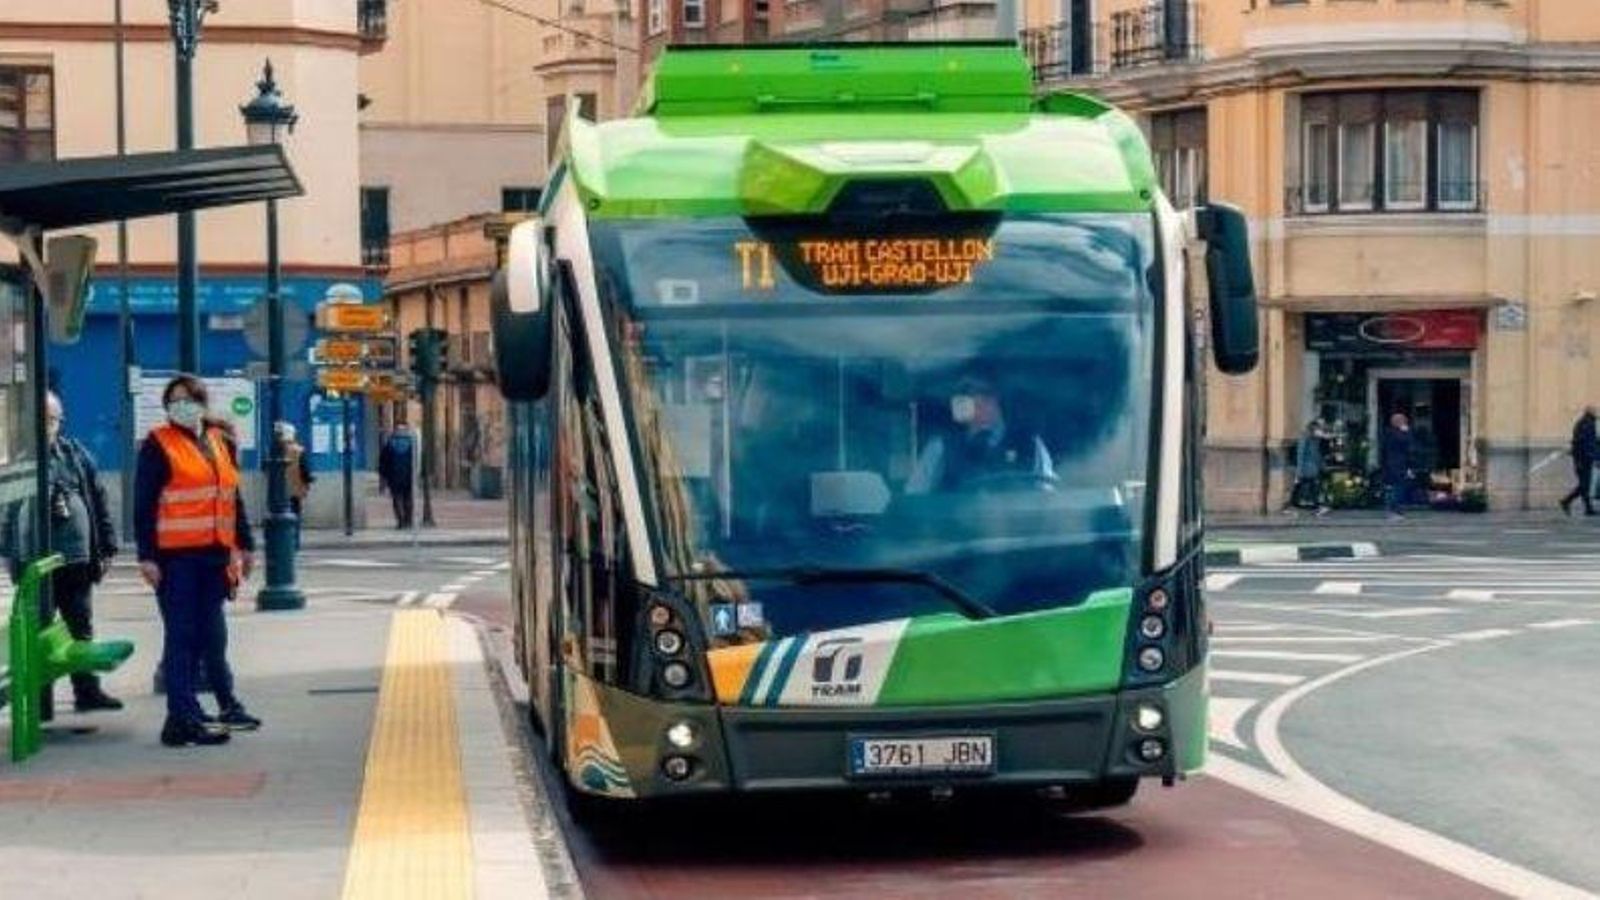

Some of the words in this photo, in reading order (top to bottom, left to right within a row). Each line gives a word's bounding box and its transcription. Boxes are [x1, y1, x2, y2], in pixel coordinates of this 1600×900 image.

[800, 241, 859, 263] TRAM
[865, 239, 994, 261] CASTELLON
[735, 242, 775, 290] T1
[812, 683, 862, 697] TRAM
[869, 744, 924, 766] 3761
[944, 742, 987, 764] JBN
